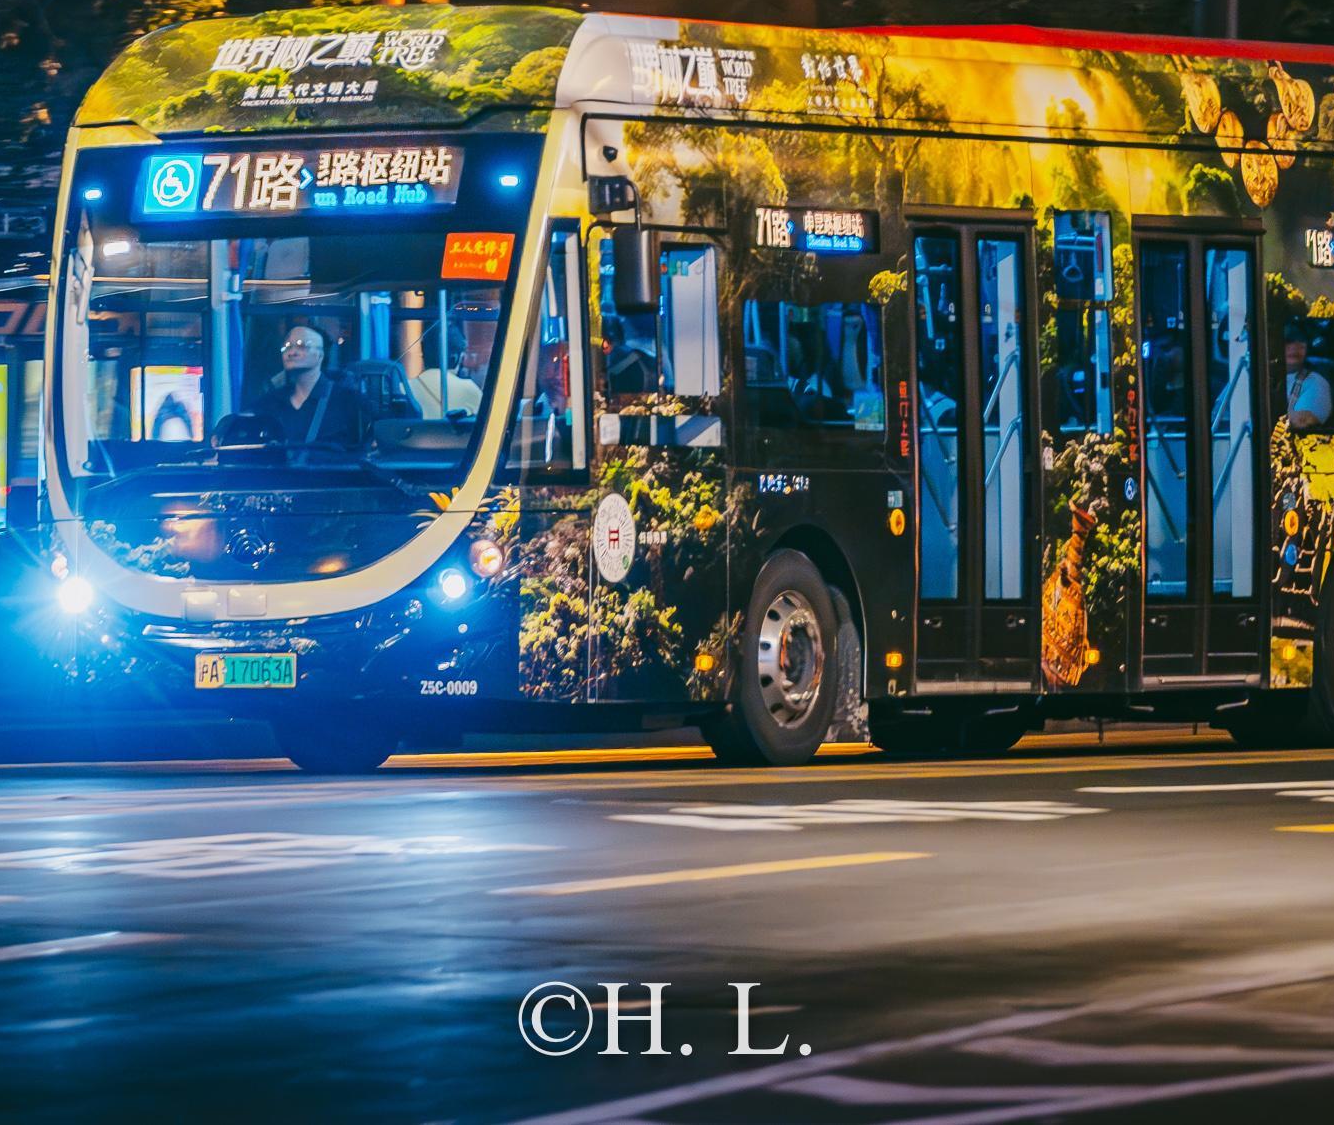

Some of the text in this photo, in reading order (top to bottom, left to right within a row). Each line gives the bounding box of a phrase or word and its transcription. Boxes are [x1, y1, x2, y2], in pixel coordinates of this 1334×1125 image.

[384, 34, 445, 48] WORLD
[376, 46, 440, 71] TREE
[721, 59, 754, 77] WORLD
[722, 76, 749, 103] TREE
[202, 152, 305, 211] 71路
[343, 185, 388, 206] Road
[392, 183, 428, 204] Hub
[756, 207, 791, 248] 71路
